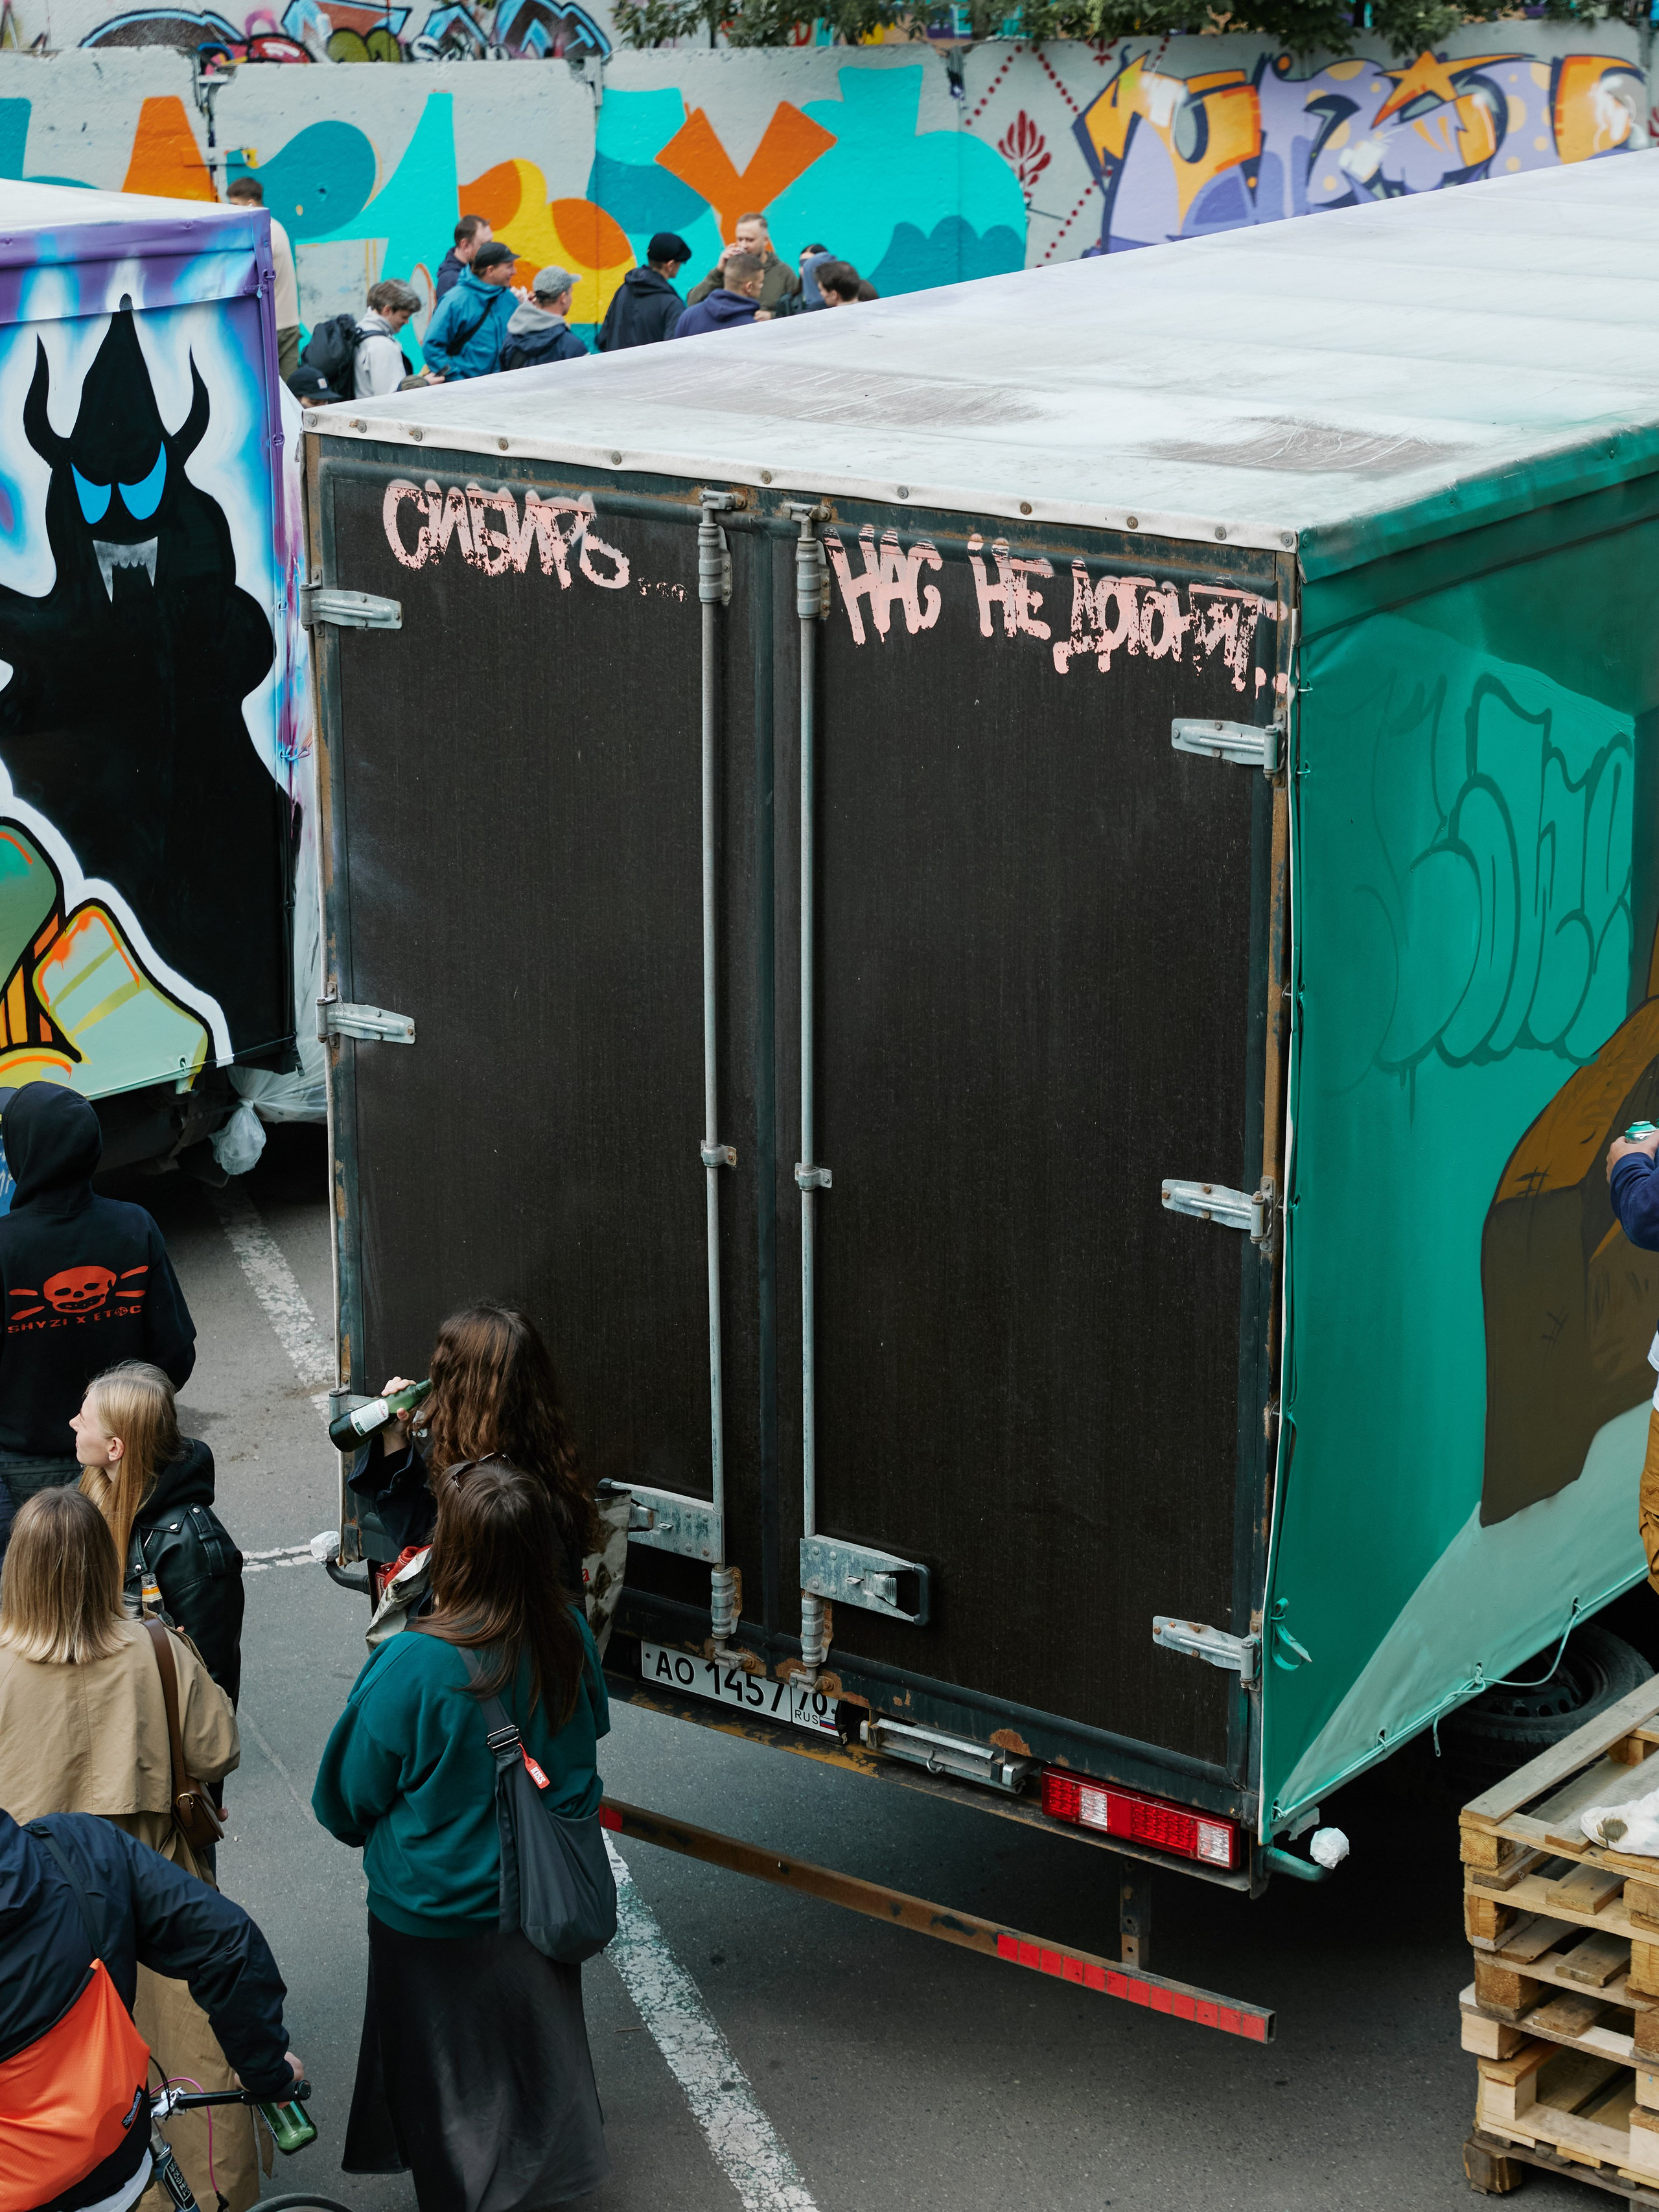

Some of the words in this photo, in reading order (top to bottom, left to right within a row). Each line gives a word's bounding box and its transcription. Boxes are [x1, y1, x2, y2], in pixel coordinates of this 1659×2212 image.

[822, 524, 943, 646] НАС
[968, 533, 1054, 641] НЕ
[8, 1318, 67, 1333] SHYZI
[704, 1662, 785, 1712] 1457
[795, 1709, 818, 1725] RUS
[529, 1765, 546, 1785] KISS
